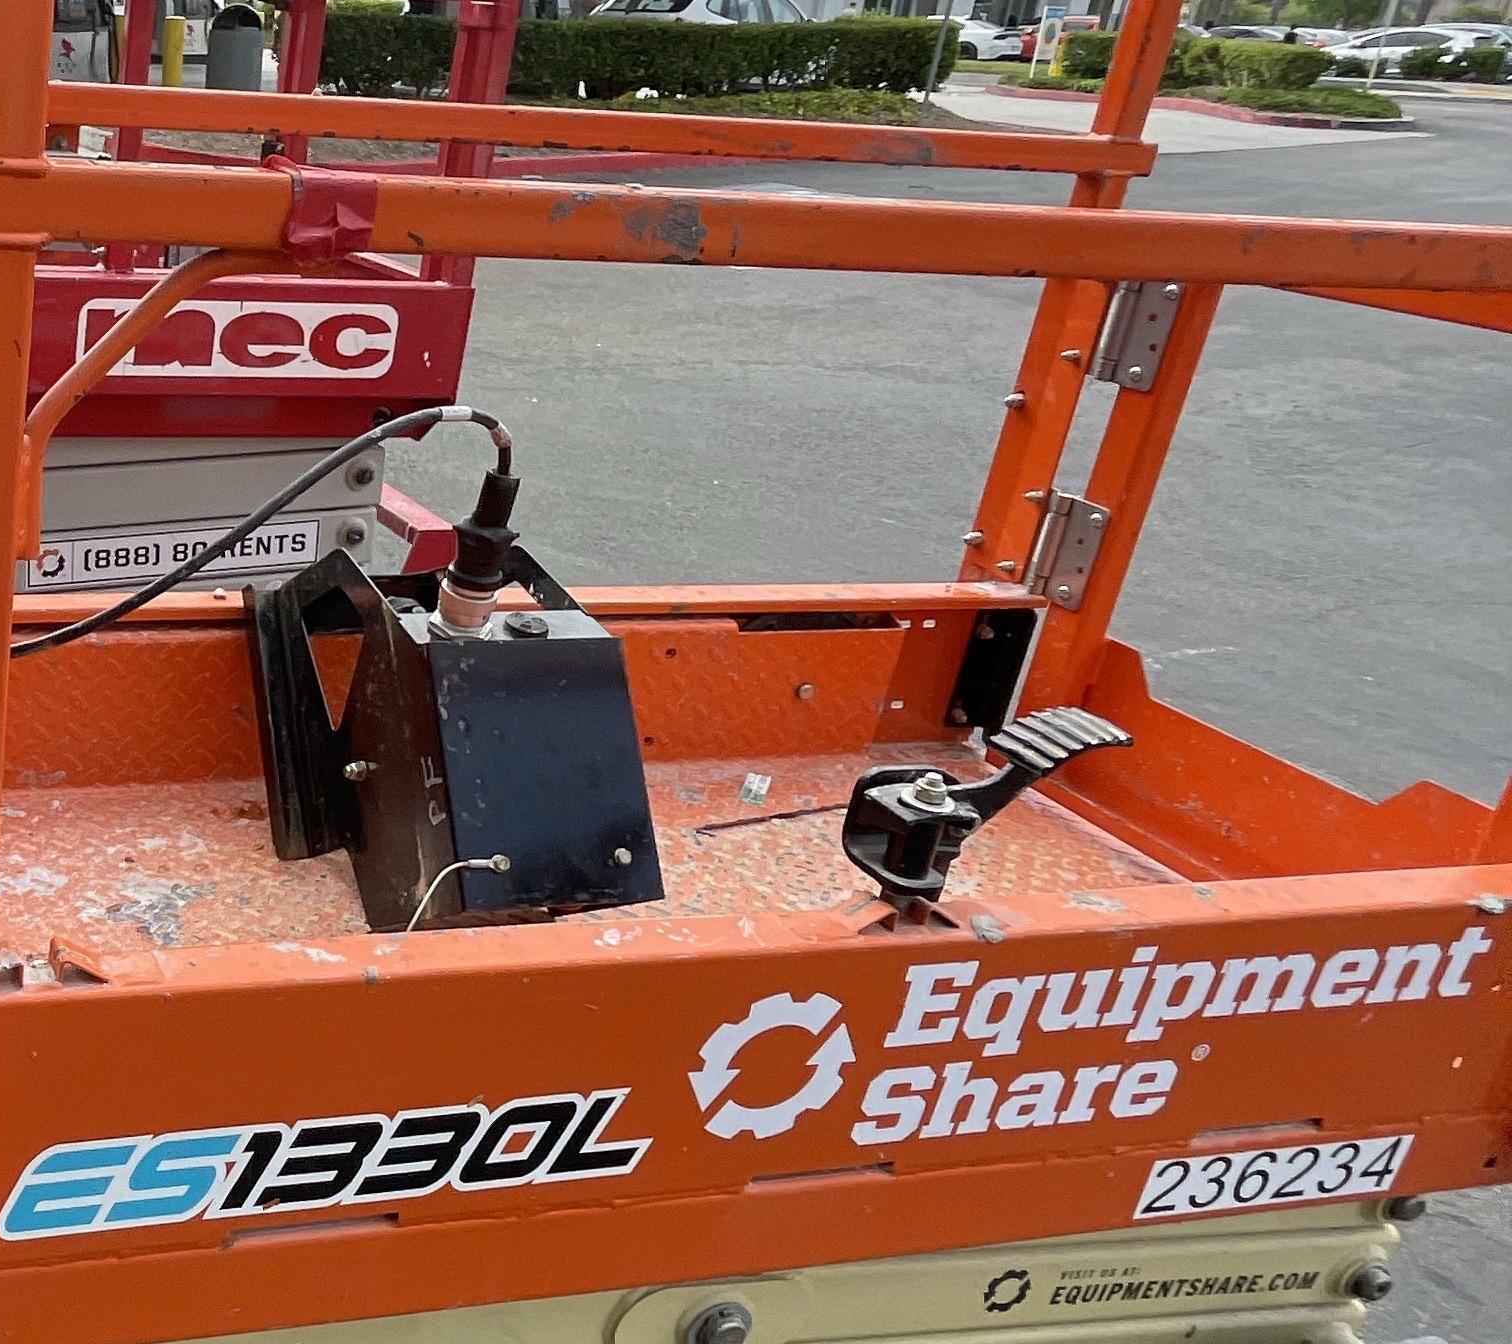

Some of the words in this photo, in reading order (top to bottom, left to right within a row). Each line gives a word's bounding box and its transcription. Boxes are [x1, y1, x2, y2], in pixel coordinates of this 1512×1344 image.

[84, 543, 159, 572] (888)
[884, 926, 1492, 1057] Equipment
[851, 1059, 1178, 1146] Share
[1140, 1137, 1402, 1215] 236234
[1049, 1271, 1321, 1305] EQUIPMENTSHARE.COM
